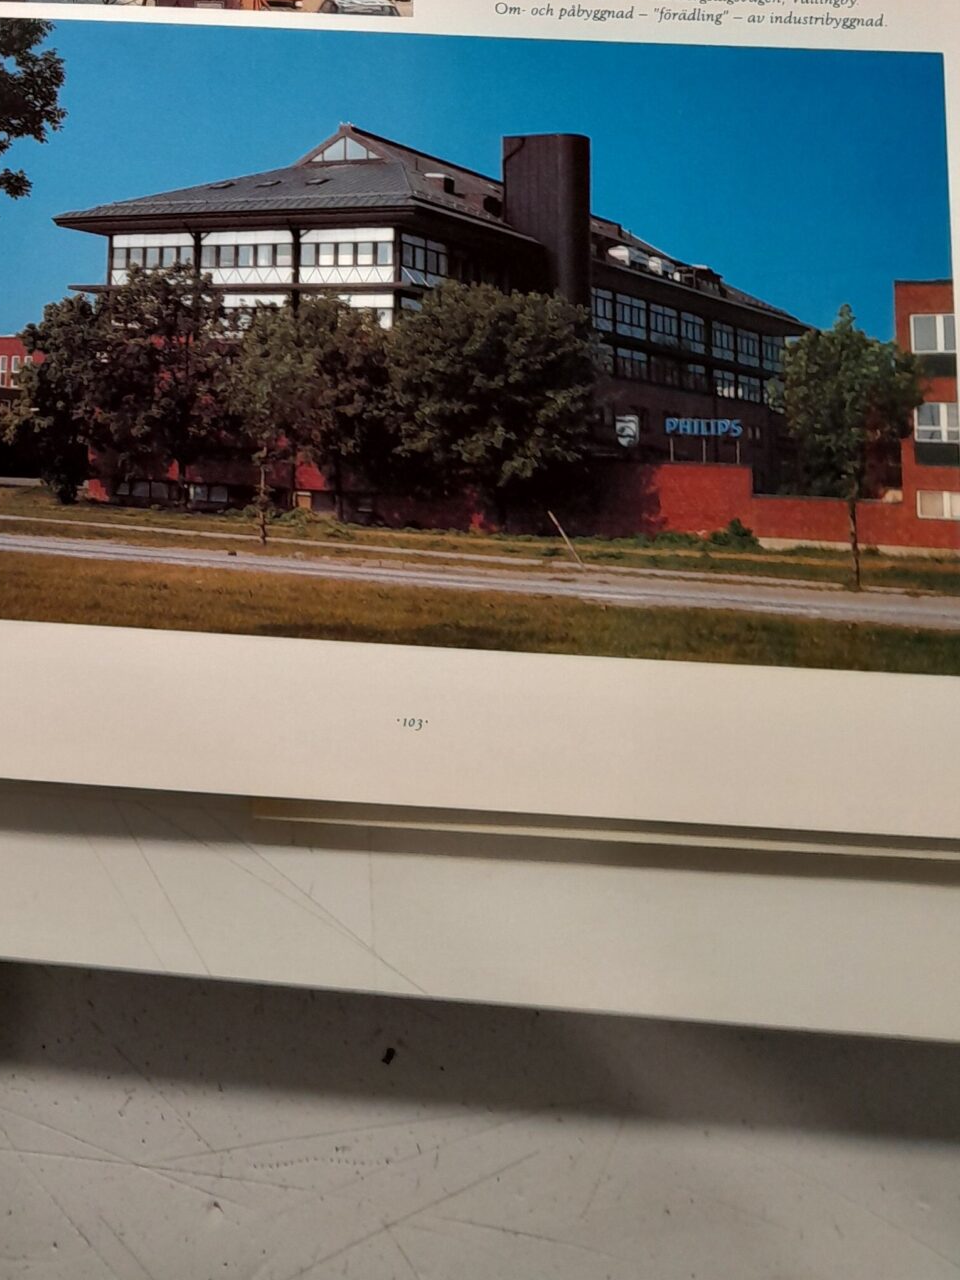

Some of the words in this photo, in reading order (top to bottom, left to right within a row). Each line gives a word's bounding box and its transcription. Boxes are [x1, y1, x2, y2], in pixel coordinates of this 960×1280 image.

[494, 2, 526, 16] Om-
[530, 3, 554, 17] och
[558, 4, 635, 22] påbyggnad
[654, 7, 729, 25] "förädling"
[747, 14, 766, 24] av
[770, 11, 888, 30] industribyggnad.
[664, 417, 743, 438] PHILIPS
